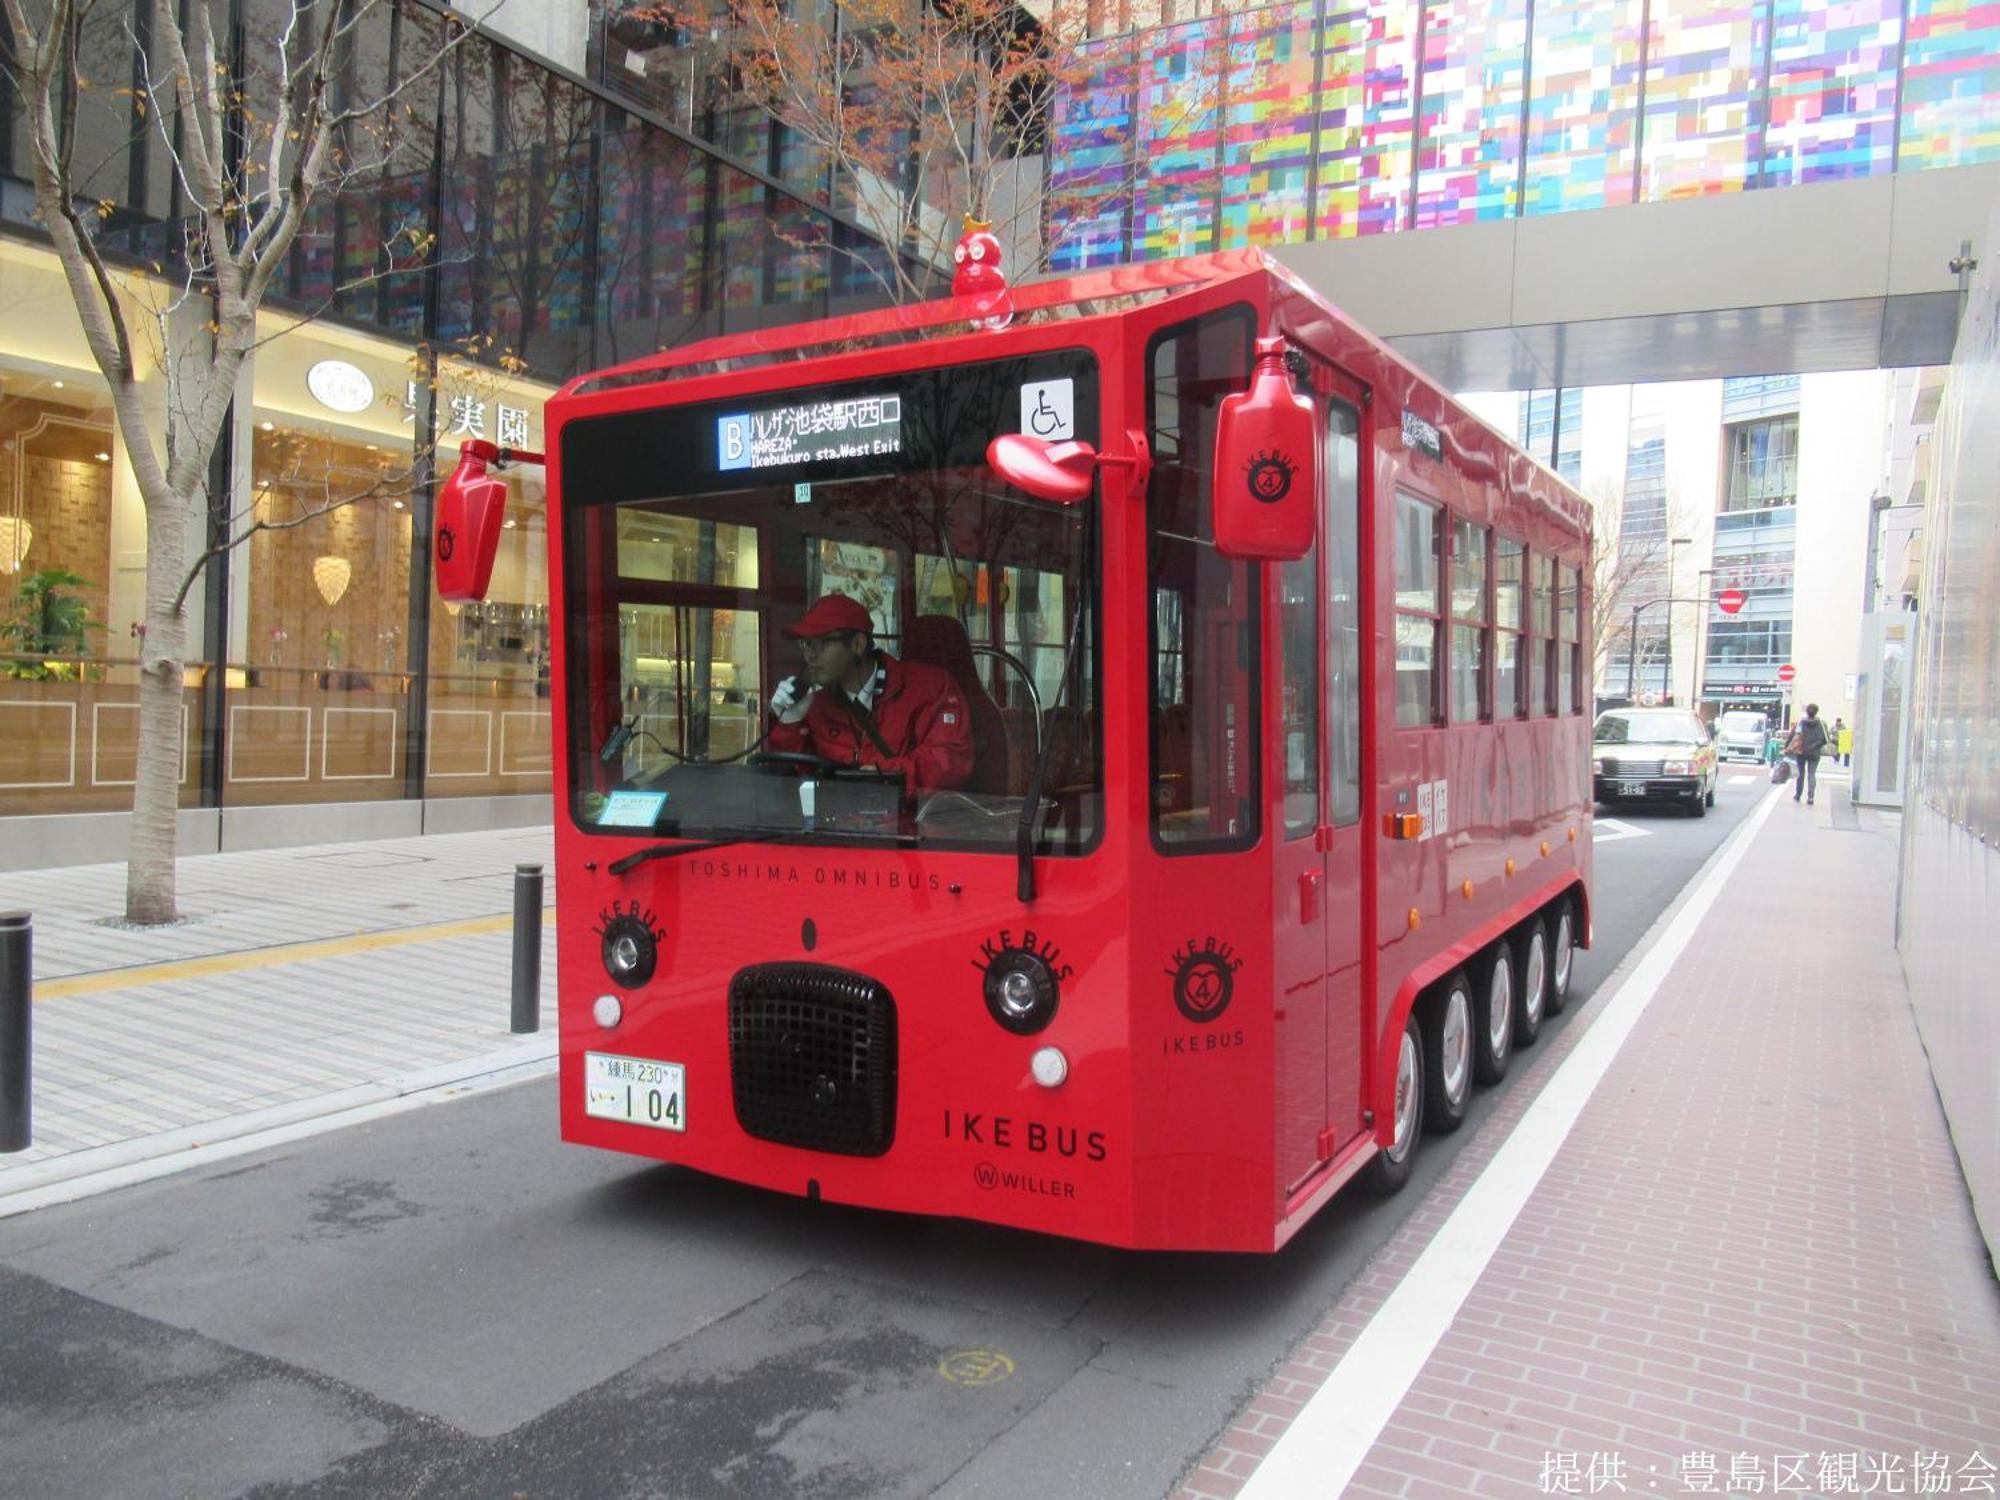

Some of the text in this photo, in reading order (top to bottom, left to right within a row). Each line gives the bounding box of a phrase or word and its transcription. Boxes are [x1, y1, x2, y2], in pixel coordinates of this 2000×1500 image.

[726, 422, 744, 461] B
[751, 450, 811, 468] Ikebukuro
[873, 439, 900, 455] Exit
[689, 860, 941, 891] TOSHIMA OMNIBUS
[1194, 979, 1211, 1001] 4
[1001, 1173, 1077, 1199] WILLER
